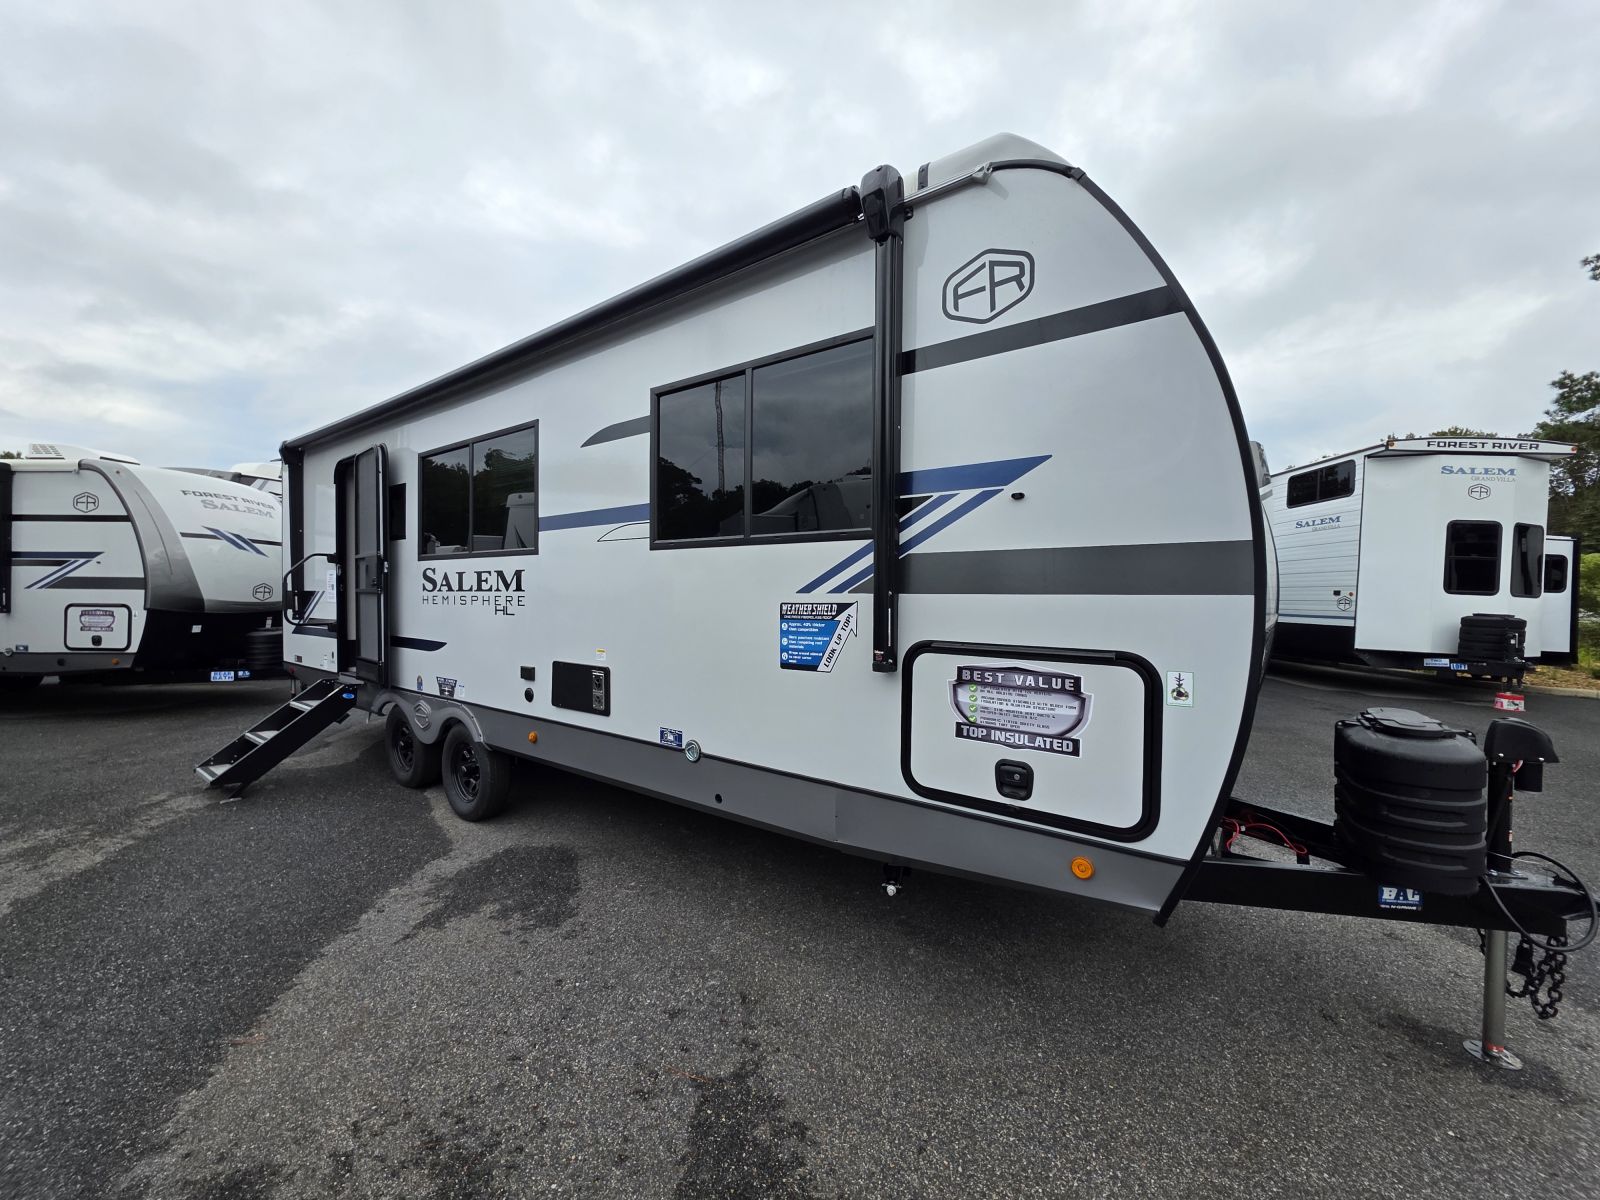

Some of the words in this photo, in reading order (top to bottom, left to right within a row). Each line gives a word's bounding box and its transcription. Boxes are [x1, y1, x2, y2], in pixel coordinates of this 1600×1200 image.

[1426, 440, 1488, 449] FOREST
[1492, 442, 1540, 450] RIVER
[1440, 465, 1517, 476] SALEM
[180, 490, 239, 501] FOREST
[241, 498, 275, 510] RIVER
[201, 500, 274, 518] SALEM
[1295, 515, 1342, 529] SALEM
[422, 567, 526, 593] SALEM
[422, 595, 526, 607] HEMISPHERE
[494, 605, 516, 616] HL
[823, 647, 837, 668] LOOK
[834, 633, 843, 646] UP
[841, 614, 853, 632] TOP!
[961, 669, 1005, 684] BEST
[1014, 674, 1075, 691] VALUE
[960, 725, 988, 739] TOP
[990, 729, 1073, 752] INSULATED
